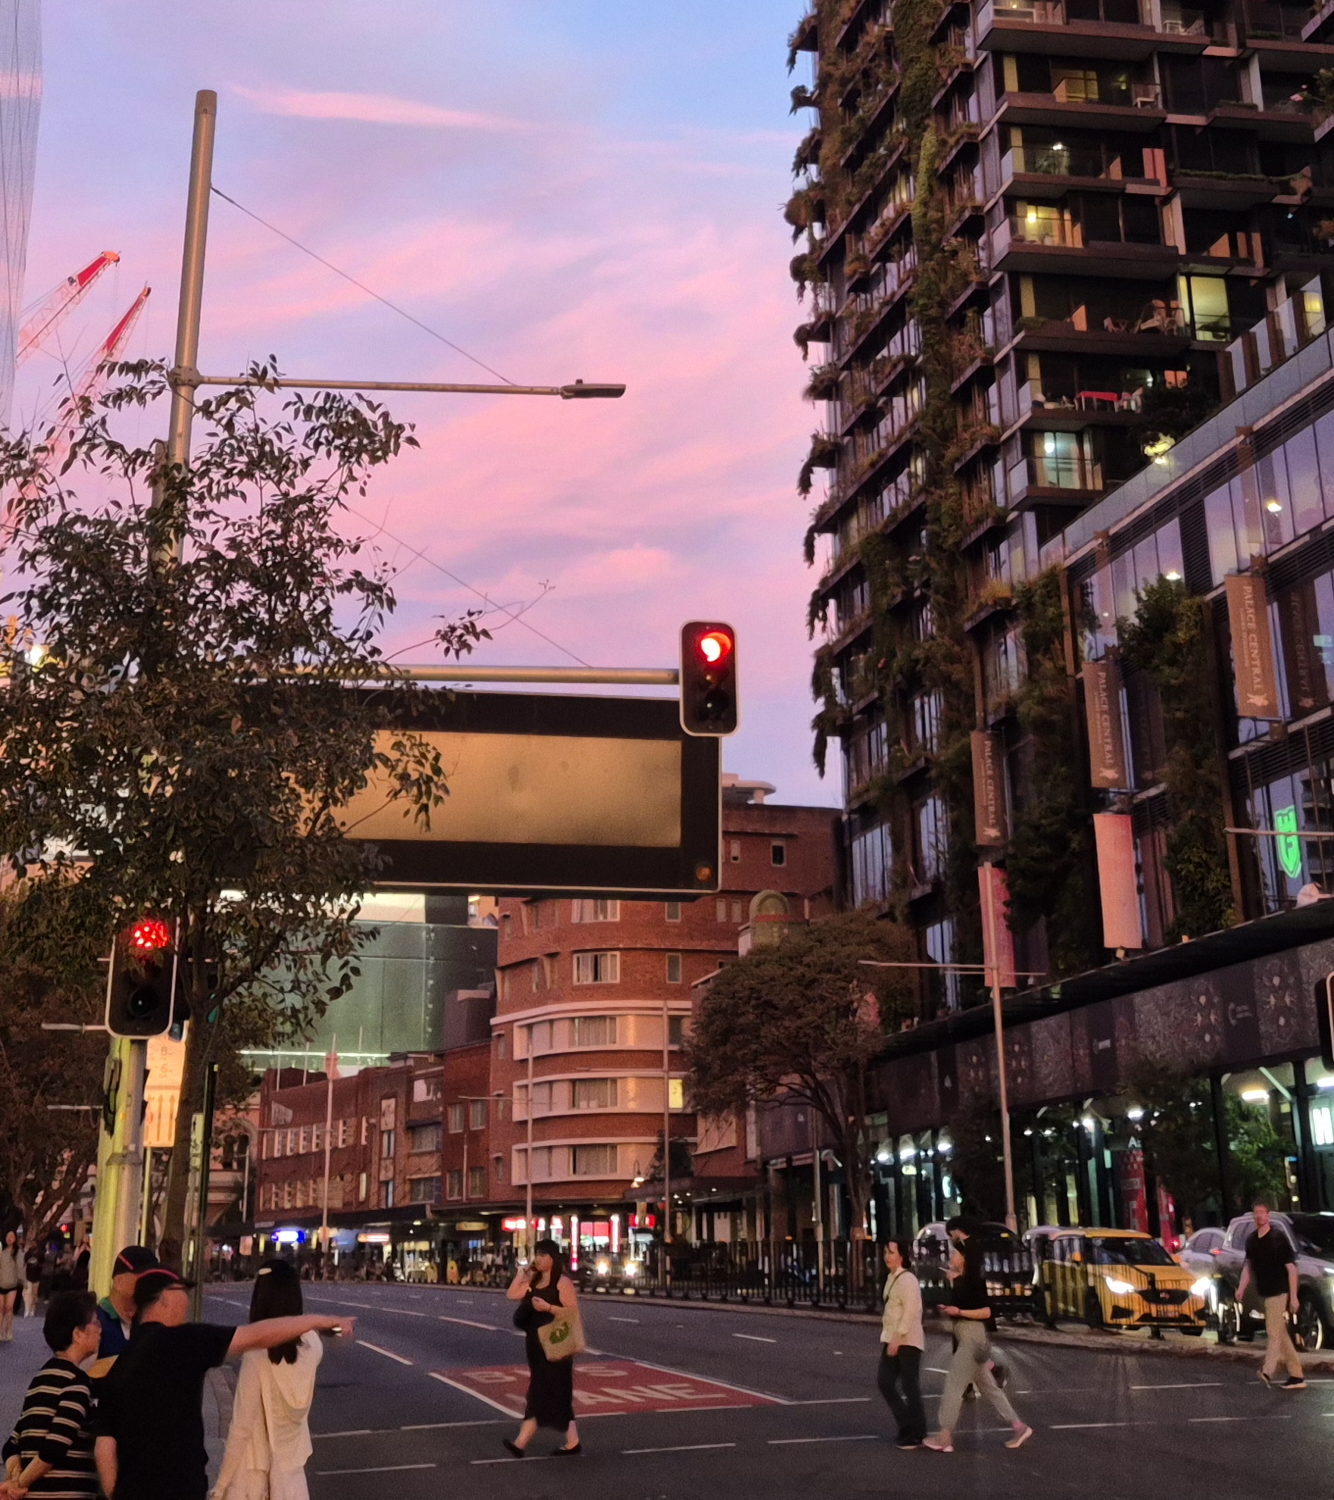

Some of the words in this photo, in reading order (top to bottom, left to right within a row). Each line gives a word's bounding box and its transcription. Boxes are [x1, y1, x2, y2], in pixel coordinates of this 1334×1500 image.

[1243, 584, 1256, 632] PALACE
[1248, 633, 1264, 691] CENTRAL
[1097, 671, 1111, 717] PALACE
[984, 739, 994, 775] PALACE
[1100, 720, 1116, 766] CENTRAL
[986, 777, 997, 827] CENTRAL
[463, 1365, 629, 1385] BS
